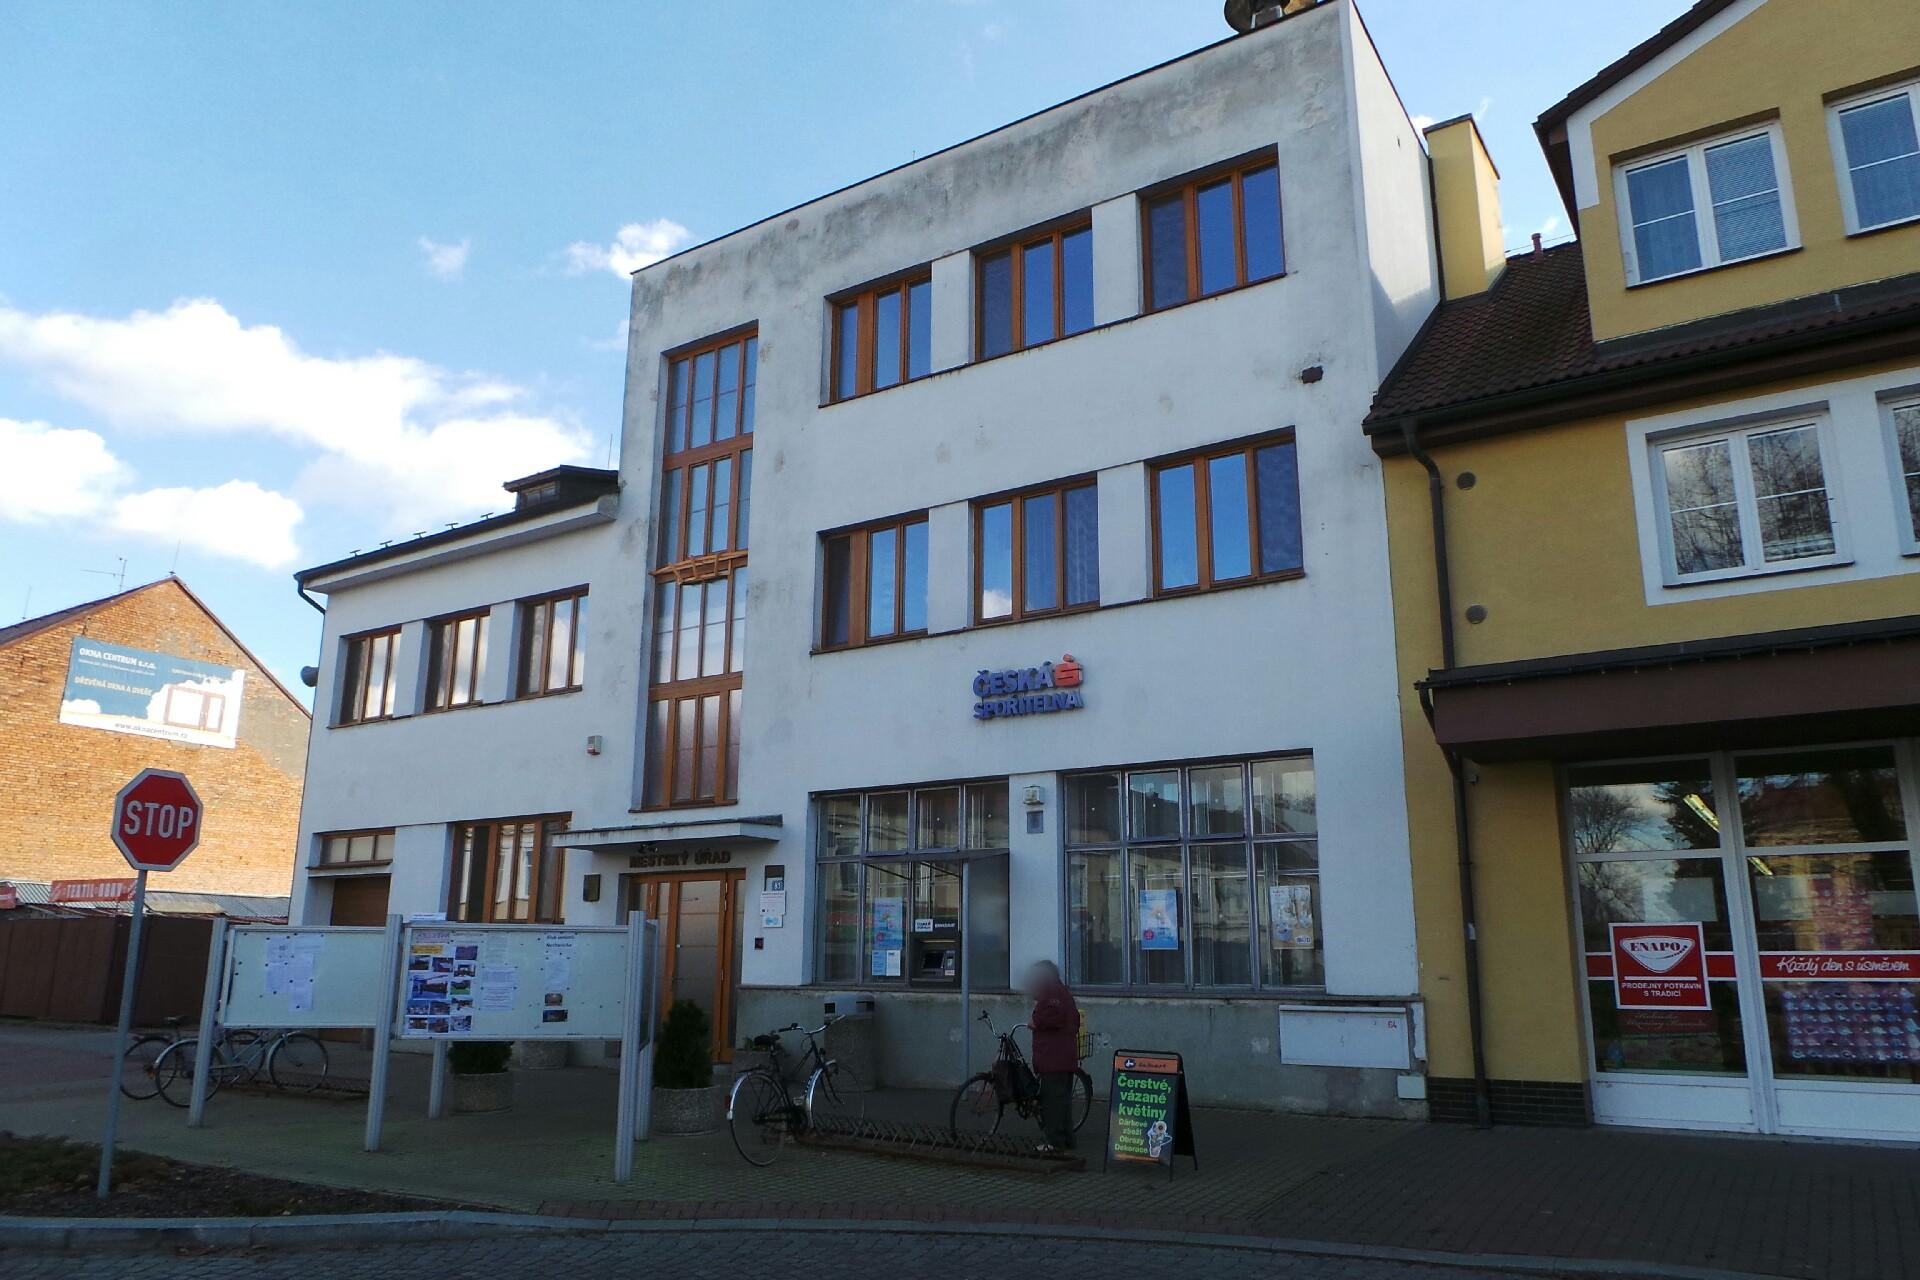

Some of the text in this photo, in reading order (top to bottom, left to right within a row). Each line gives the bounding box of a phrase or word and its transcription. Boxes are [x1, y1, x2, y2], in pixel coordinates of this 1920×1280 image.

[103, 652, 137, 666] CENTRUM
[973, 661, 1054, 698] ČESKÁ
[973, 690, 1085, 719] SPOŘITELNA
[124, 800, 194, 839] STOP
[694, 847, 731, 865] ÚŘAD
[1630, 942, 1681, 952] ENAPO
[1776, 956, 1910, 976] Každý den s úsměvem
[1622, 982, 1702, 990] PRODEJNY POTRAVIN
[1651, 989, 1681, 997] TRADICÍ
[1117, 1073, 1172, 1093] Čerstvé,
[1120, 1089, 1167, 1105] vázané
[1118, 1103, 1167, 1121] květiny
[1118, 1118, 1148, 1129] Dárkové
[1114, 1143, 1149, 1154] Dekorace
[1119, 1135, 1145, 1146] Obrazy
